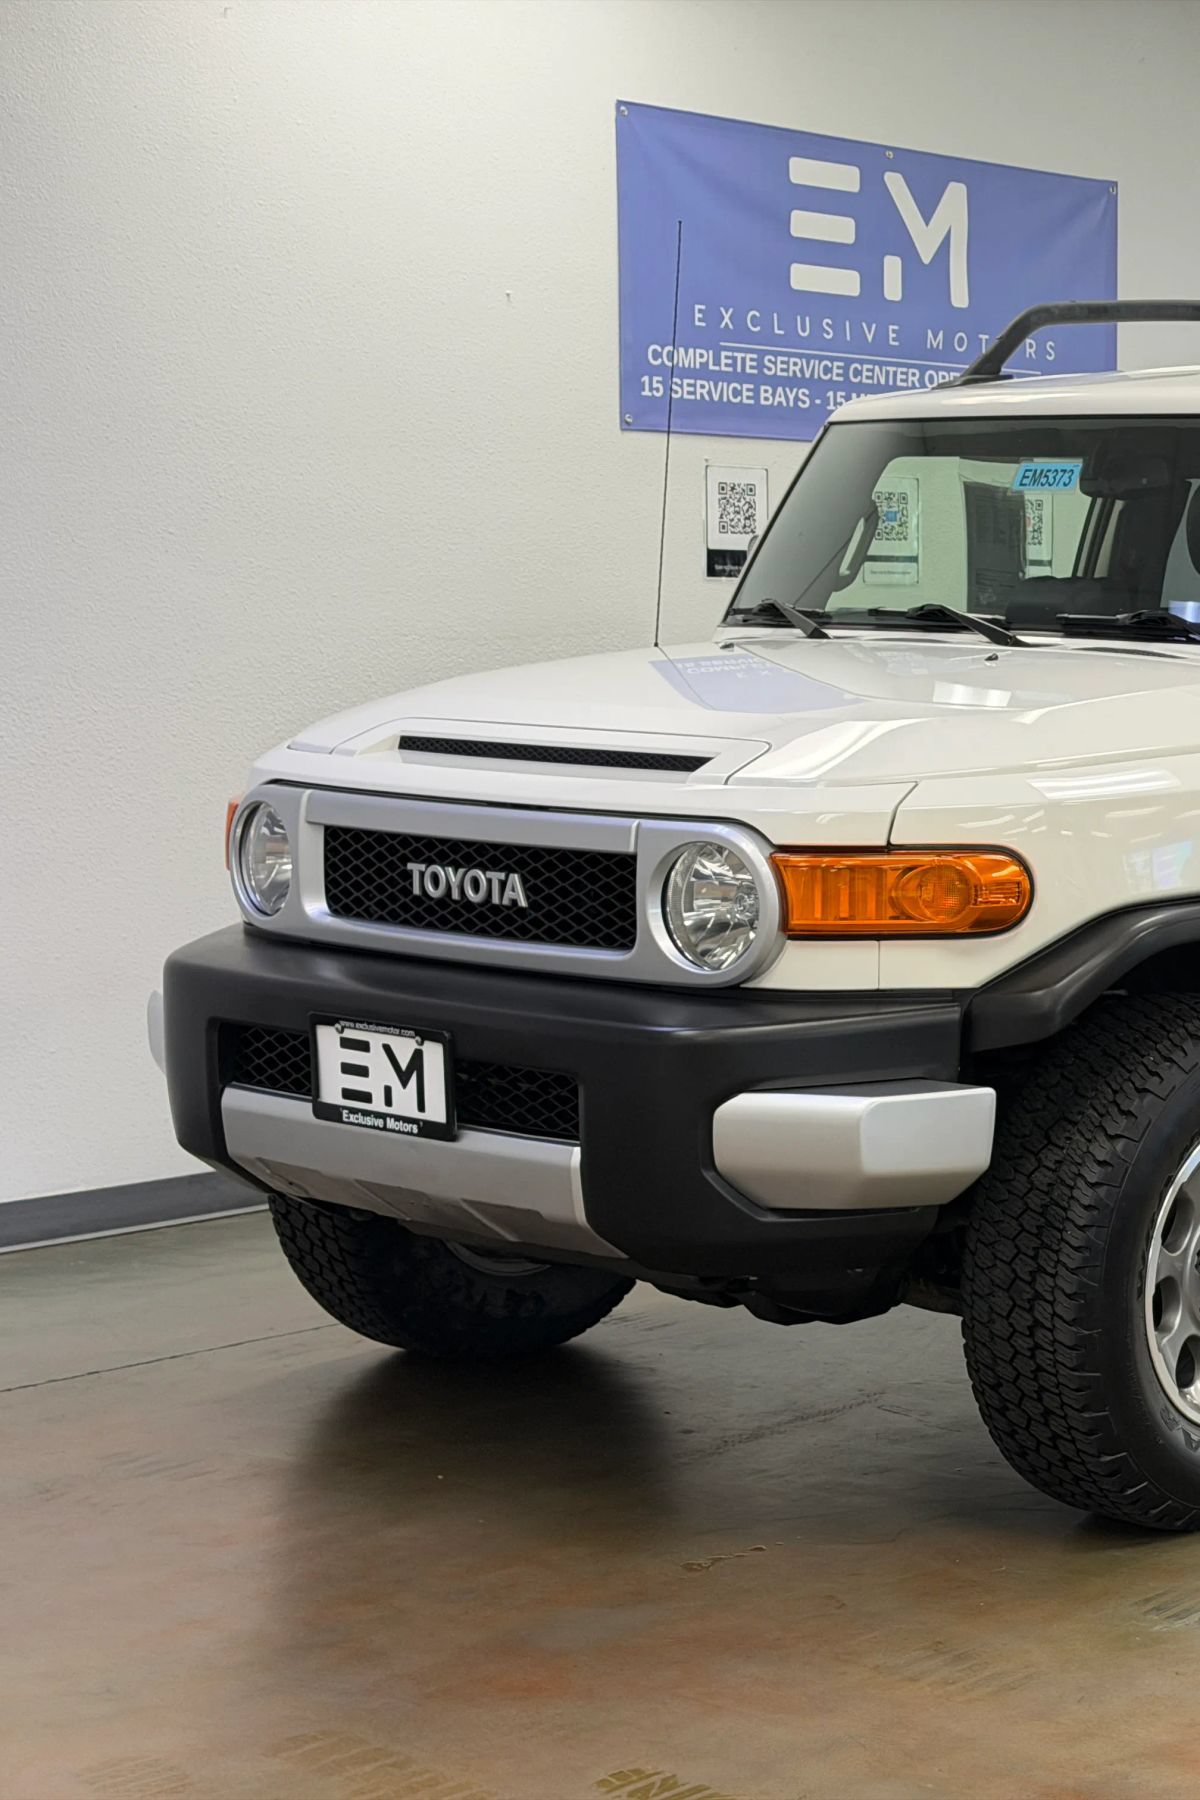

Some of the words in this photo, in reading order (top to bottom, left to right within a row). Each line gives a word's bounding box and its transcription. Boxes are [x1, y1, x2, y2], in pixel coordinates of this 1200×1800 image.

[789, 156, 970, 309] EM
[693, 303, 901, 347] EXCLUSIVE
[926, 328, 1057, 362] MOTRS
[647, 343, 759, 374] COMPLETE
[763, 354, 845, 382] SERVICE
[848, 361, 920, 389] CENTER
[640, 375, 664, 398] 15
[670, 377, 755, 405] SERVICE
[759, 384, 811, 409] BAYS
[826, 390, 847, 411] 15
[1018, 468, 1075, 488] EM5373
[406, 862, 529, 908] TOYOTA
[339, 1036, 426, 1113] EM
[342, 1109, 385, 1129] Exclusive
[386, 1117, 419, 1134] Motors
